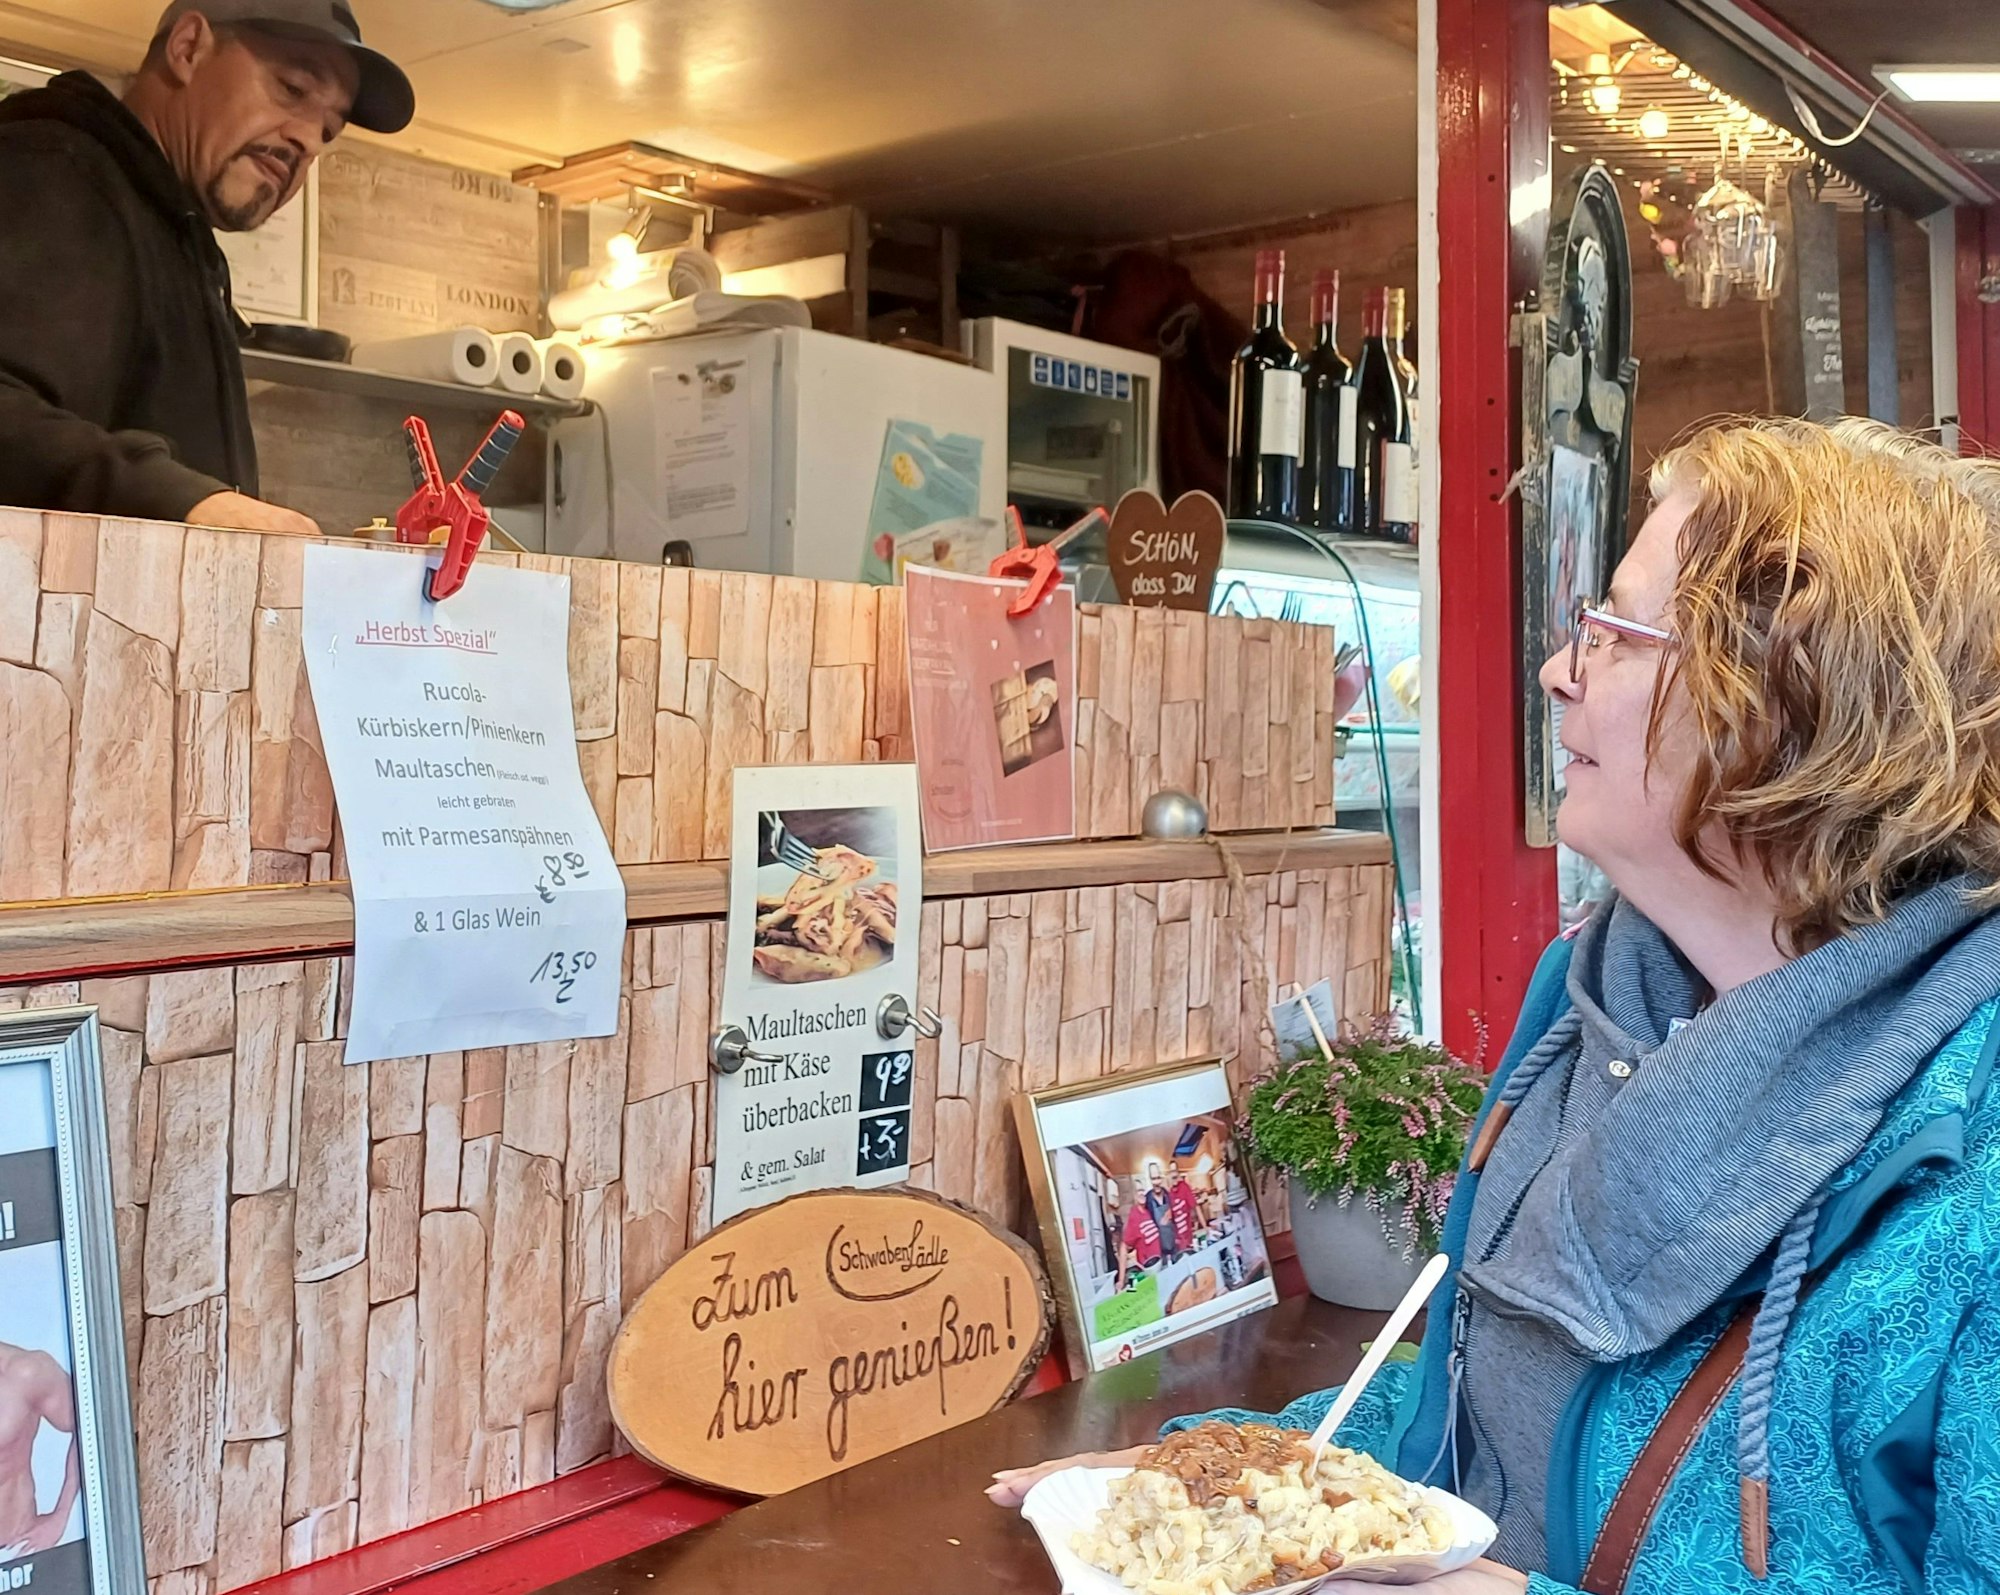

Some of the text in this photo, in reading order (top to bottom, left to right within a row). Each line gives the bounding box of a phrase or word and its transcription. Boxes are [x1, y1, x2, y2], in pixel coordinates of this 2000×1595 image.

[446, 284, 531, 316] LONDON
[1132, 572, 1166, 596] dass
[423, 682, 487, 703] Rucola-
[356, 715, 546, 746] Kürbiskern/Pinienkern
[374, 756, 497, 779] Maultaschen
[437, 795, 516, 810] leicht gebraten
[381, 825, 574, 849] mit Parmesanspähnen
[413, 906, 541, 933] & 1 Glas Wein
[746, 1003, 867, 1043] Maultaschen
[743, 1052, 831, 1088] mit Käse
[742, 1090, 853, 1133] überbacken
[740, 1146, 826, 1182] & gem. Salat
[691, 1251, 799, 1331] Zum
[706, 1275, 1017, 1463] hier genießen!
